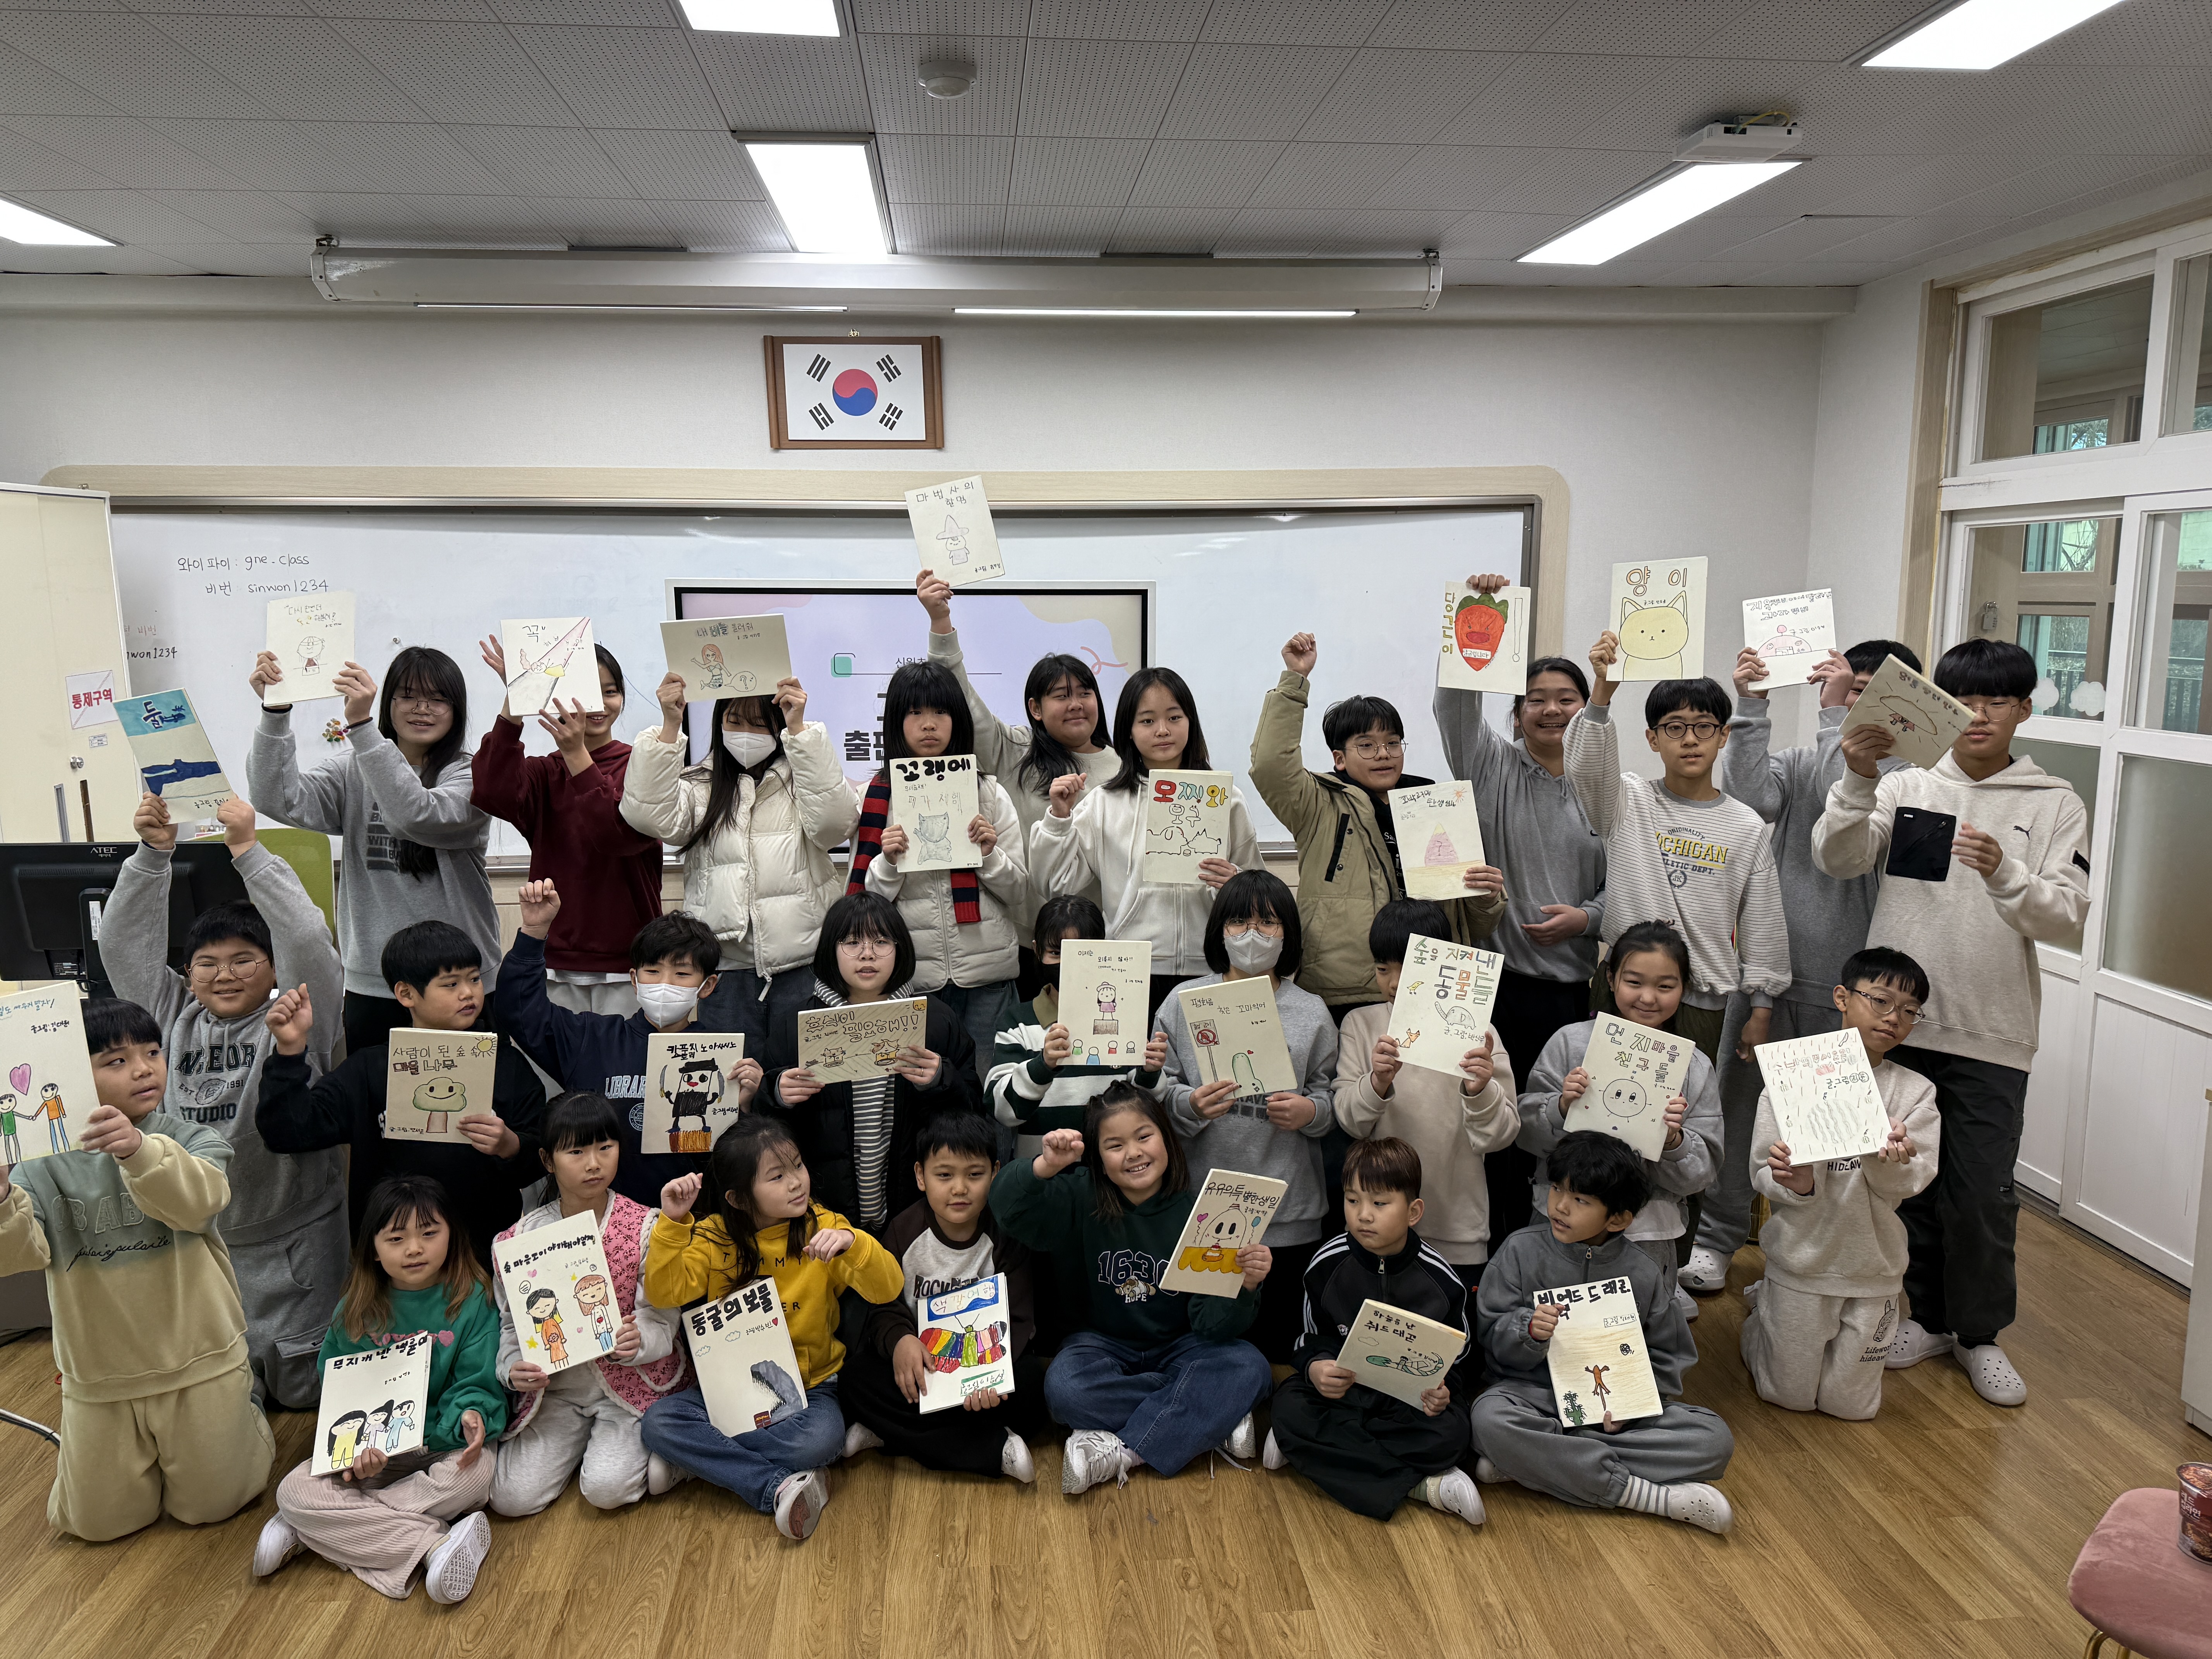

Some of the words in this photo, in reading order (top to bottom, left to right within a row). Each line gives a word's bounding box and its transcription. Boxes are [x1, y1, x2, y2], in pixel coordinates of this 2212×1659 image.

[206, 582, 231, 596] 비번
[248, 580, 328, 592] sinwon1234
[72, 689, 112, 709] 통제구역
[1692, 865, 1715, 875] DEPT.
[1434, 965, 1494, 1005] 동물들
[393, 1046, 431, 1060] 사람이
[438, 1045, 450, 1058] 된
[423, 1059, 458, 1072] 나무
[1614, 1051, 1669, 1083] 친구들
[179, 1083, 195, 1095] EST
[691, 1297, 742, 1336] 동굴의
[742, 1283, 773, 1314] 보물
